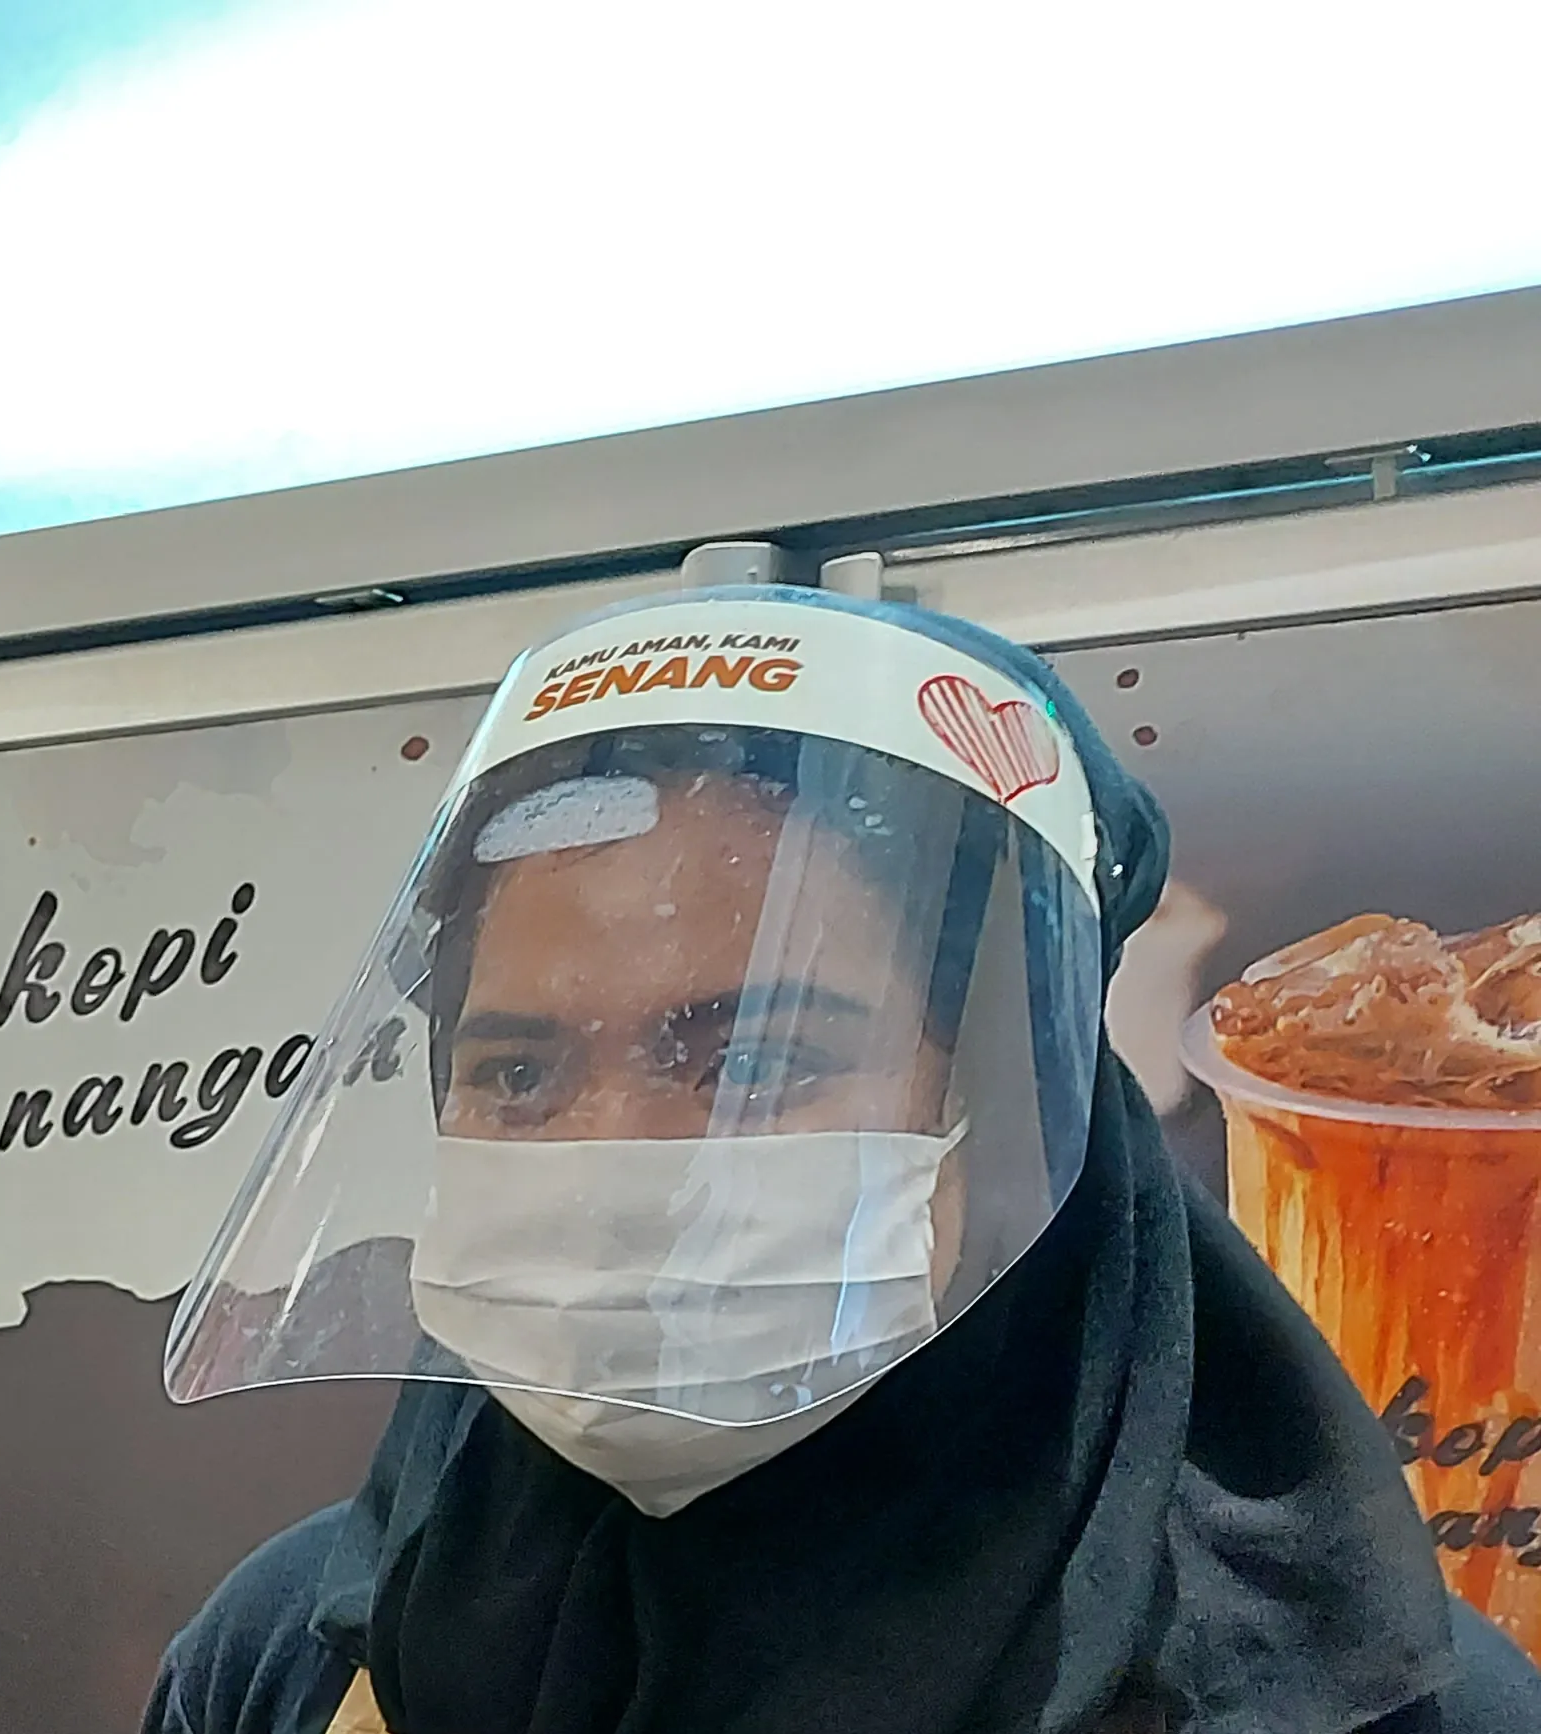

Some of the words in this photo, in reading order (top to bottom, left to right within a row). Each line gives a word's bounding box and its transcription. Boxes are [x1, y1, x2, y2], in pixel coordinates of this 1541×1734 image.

[544, 646, 618, 683] KAMU
[619, 634, 713, 659] AMAN,
[719, 634, 801, 652] KAMI
[523, 655, 805, 722] SENANG
